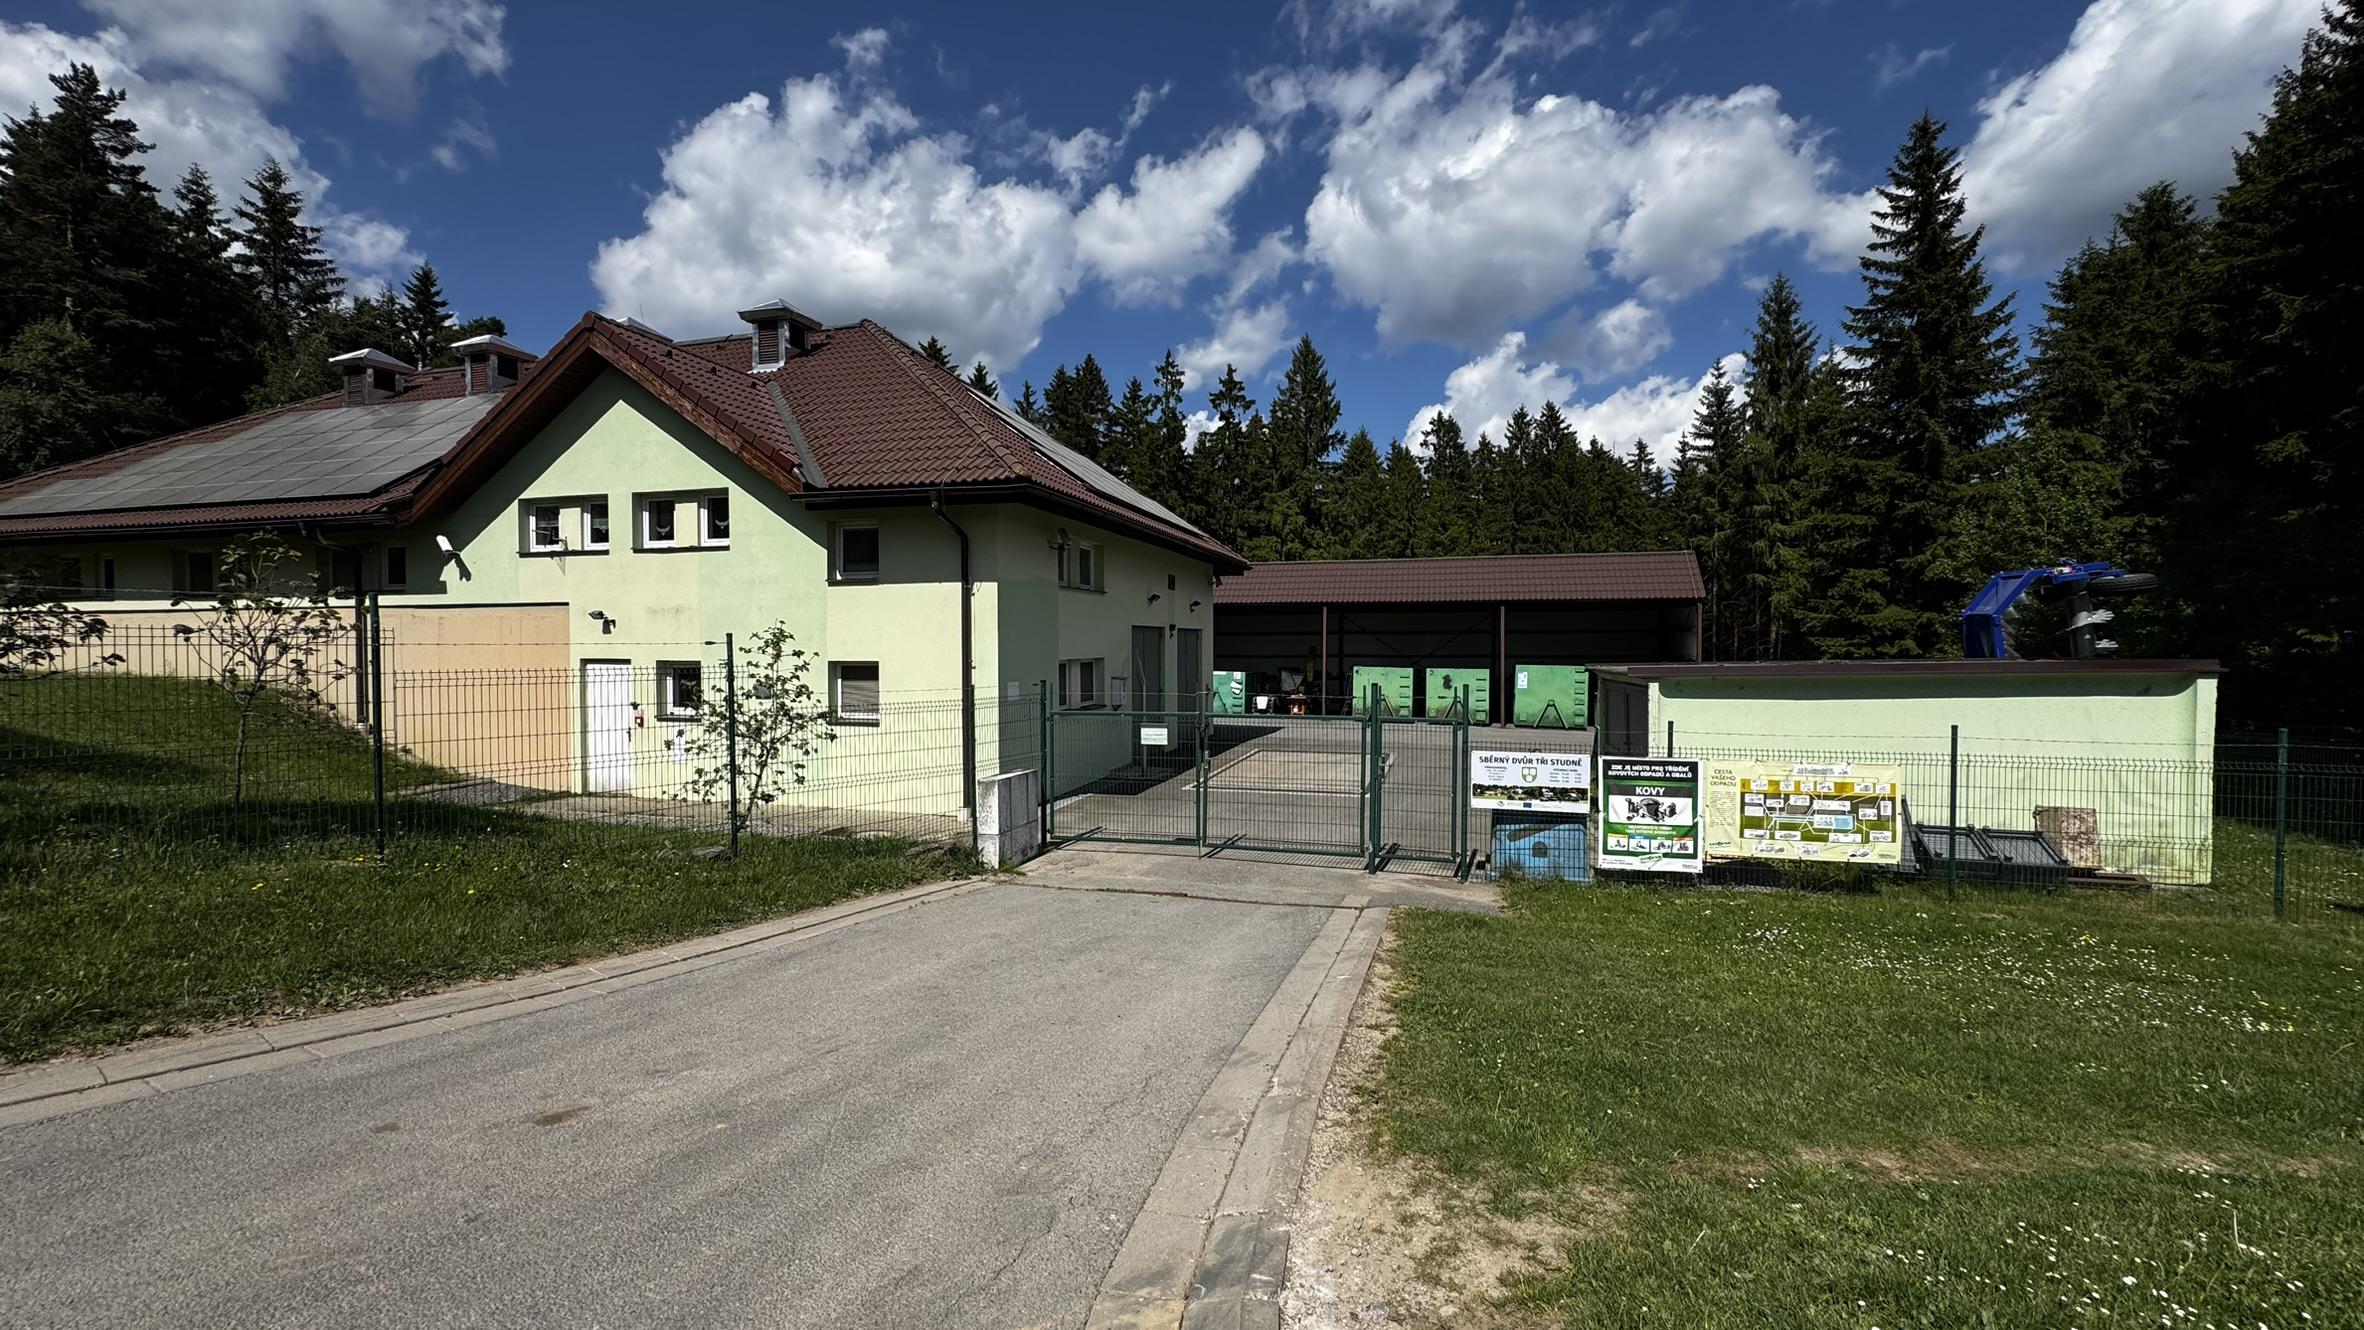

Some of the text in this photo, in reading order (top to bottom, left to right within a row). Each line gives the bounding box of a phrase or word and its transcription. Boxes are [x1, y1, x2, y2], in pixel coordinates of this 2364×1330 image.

[1479, 755, 1583, 767] SBĚRNÝ DVŮR TŘI STUDNĚ
[1635, 786, 1666, 796] KOVY
